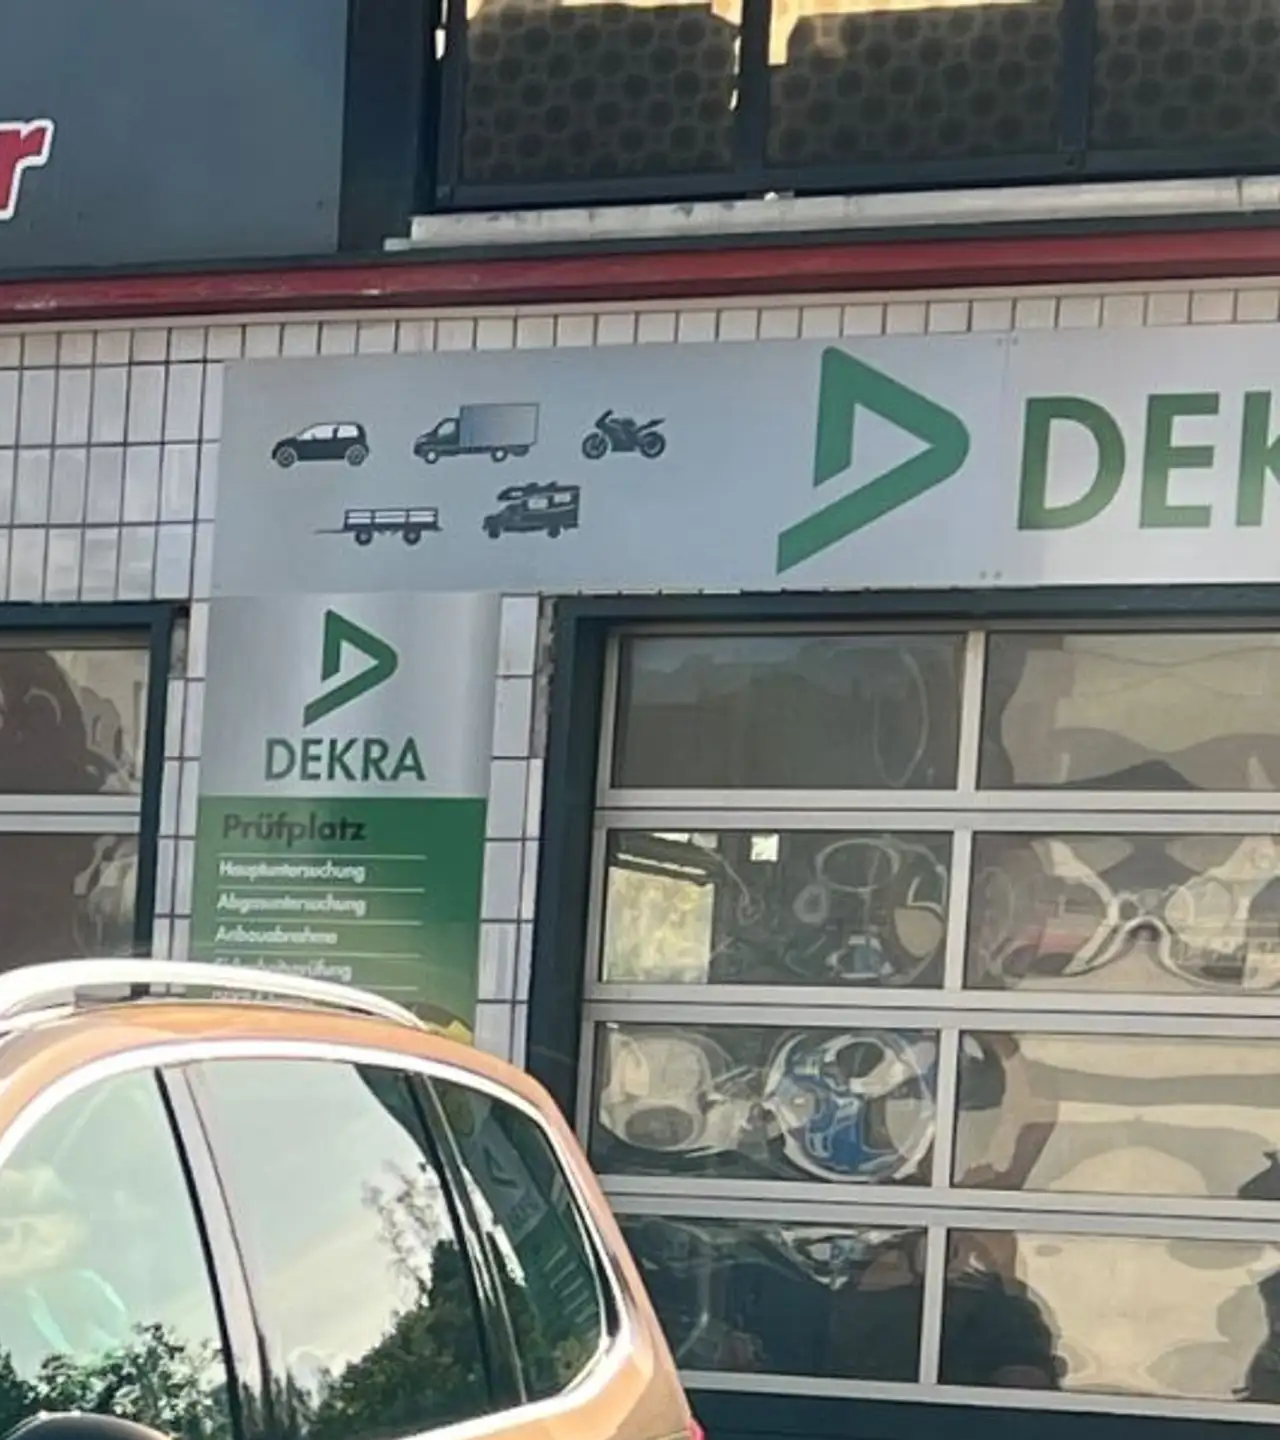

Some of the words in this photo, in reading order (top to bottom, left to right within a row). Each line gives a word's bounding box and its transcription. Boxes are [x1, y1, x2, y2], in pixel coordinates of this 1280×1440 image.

[263, 736, 426, 782] DEKRA
[222, 811, 369, 848] Prüfplatz
[218, 859, 366, 883] Hauptuntersuchung
[216, 892, 366, 917] Abgasuntersuchung
